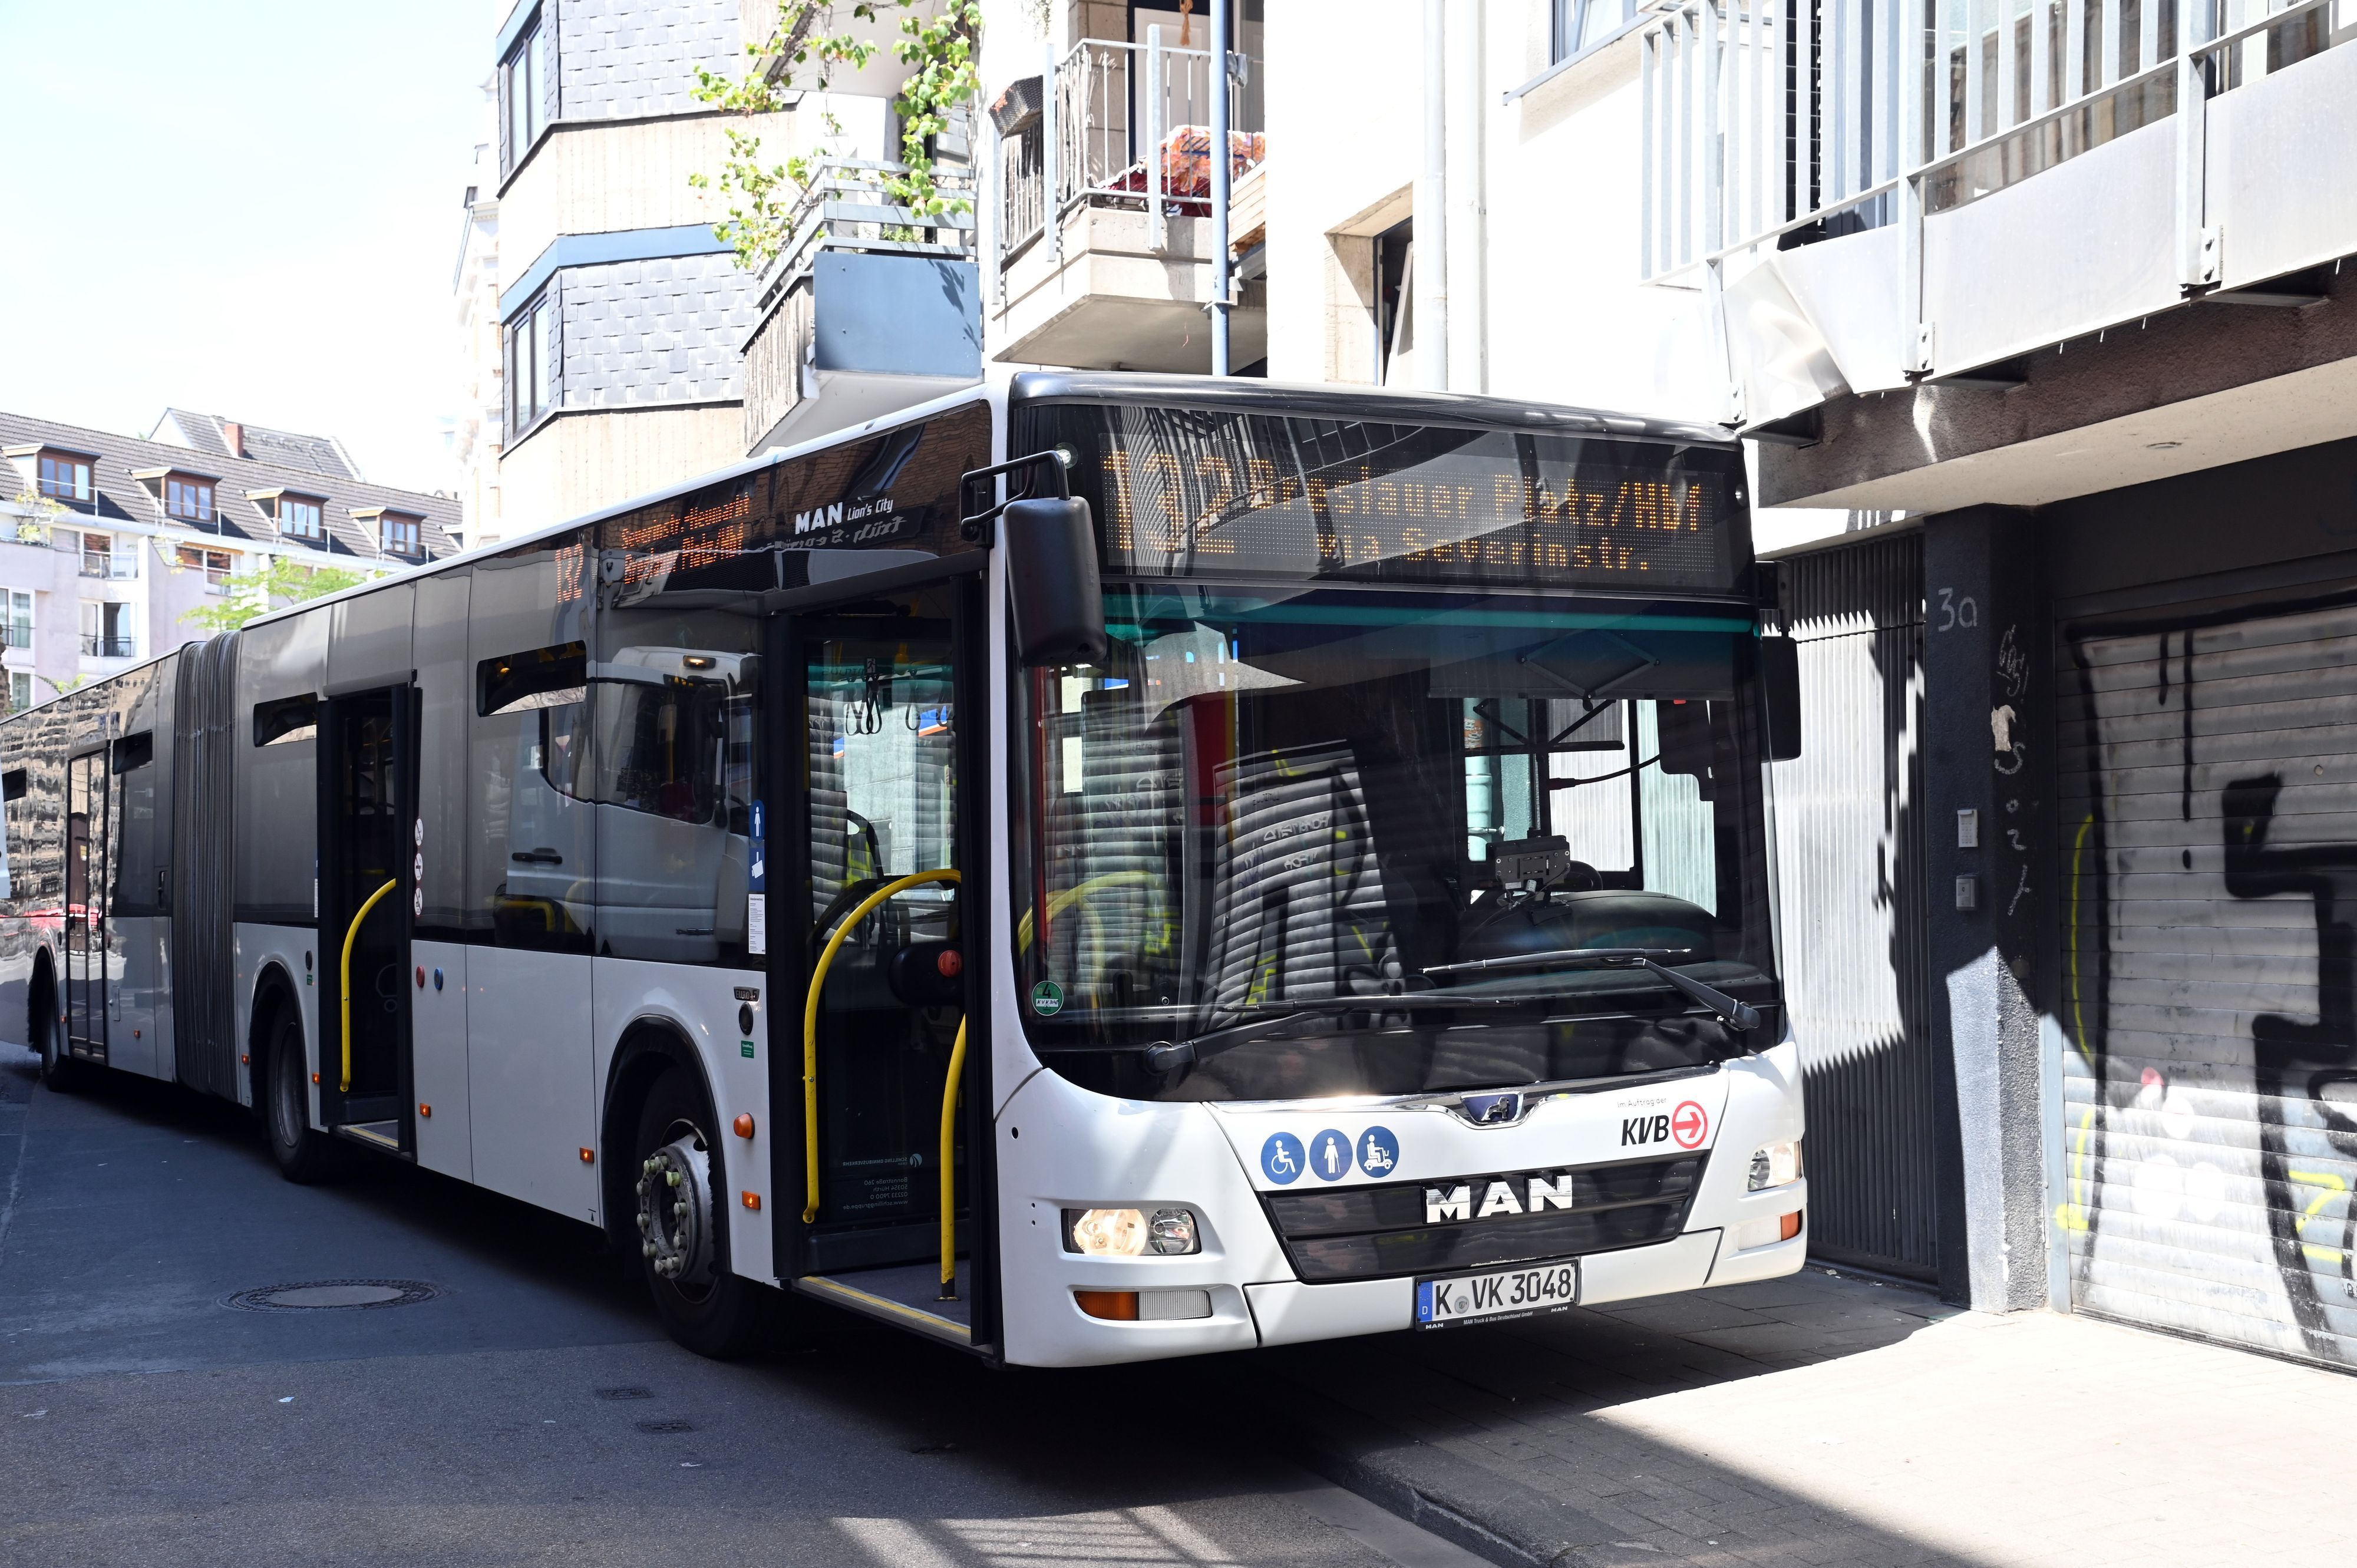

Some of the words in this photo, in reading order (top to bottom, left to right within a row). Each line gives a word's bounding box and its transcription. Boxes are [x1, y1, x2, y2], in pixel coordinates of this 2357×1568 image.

[795, 502, 843, 534] MAN
[847, 503, 872, 521] Lion's
[875, 497, 893, 514] City
[1102, 450, 1236, 553] 132
[1248, 458, 1473, 519] Breslauer
[1494, 473, 1701, 531] Platz/Hbf
[1316, 525, 1379, 558] via
[1401, 527, 1648, 570] Severinstr.
[555, 543, 584, 603] 132
[1939, 587, 1978, 632] 3a
[1042, 983, 1052, 998] 4
[1628, 1098, 1655, 1107] Auftrag
[1622, 1115, 1669, 1146] KVB
[1424, 1174, 1573, 1224] MAN
[1421, 1306, 1428, 1315] D
[1435, 1283, 1453, 1315] K
[1472, 1276, 1504, 1309] VK
[1510, 1269, 1571, 1304] 3048
[1497, 1312, 1521, 1321] Deutschland
